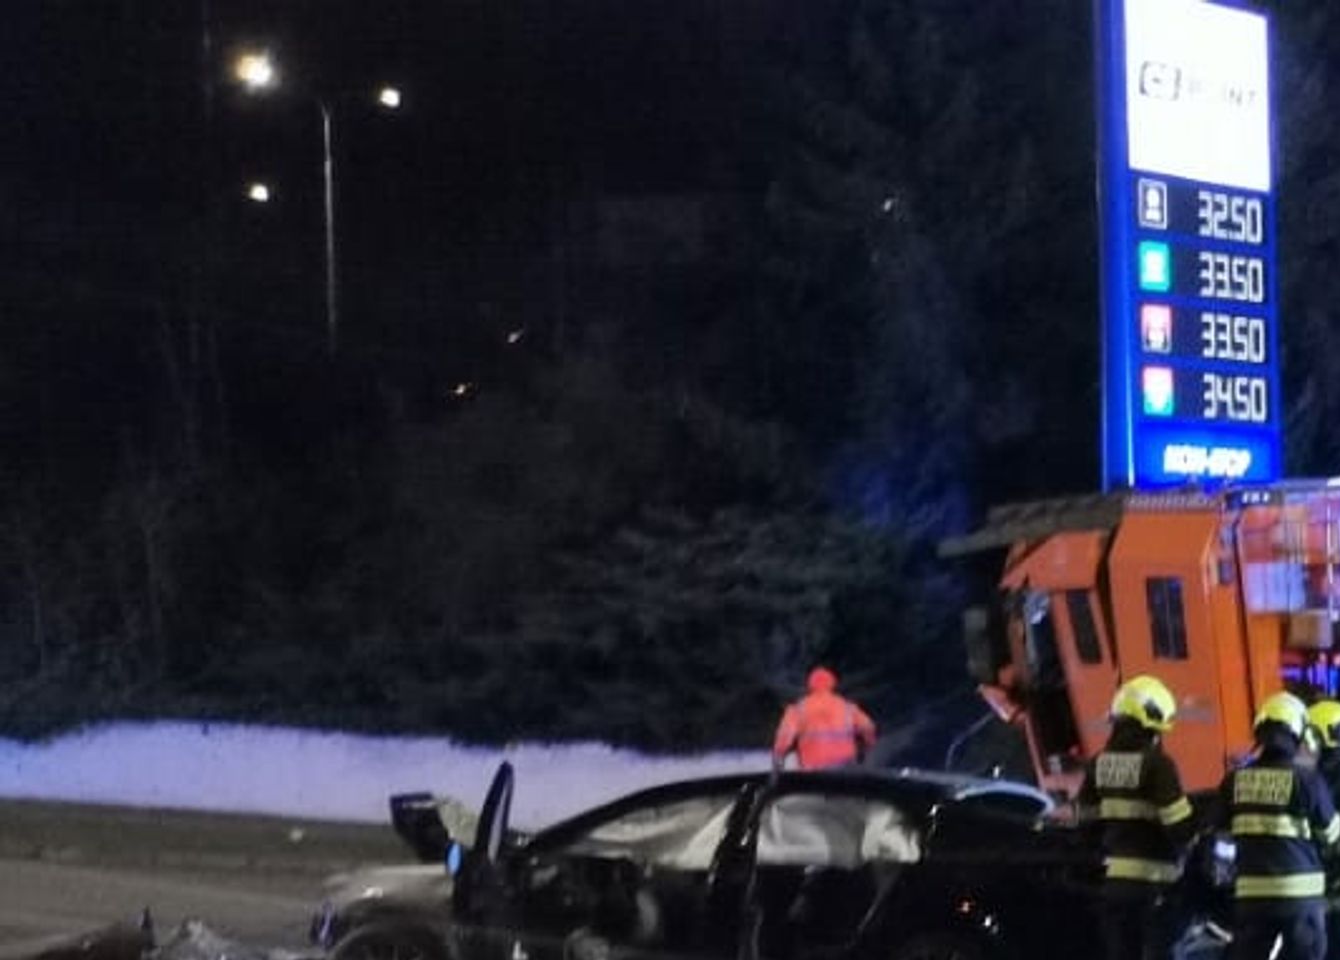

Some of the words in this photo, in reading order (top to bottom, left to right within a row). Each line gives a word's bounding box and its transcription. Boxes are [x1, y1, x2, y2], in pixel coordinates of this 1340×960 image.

[1199, 190, 1263, 243] 32.50
[1199, 251, 1264, 303] 33.50
[1201, 312, 1265, 363] 33.50
[1203, 373, 1267, 423] 34.50
